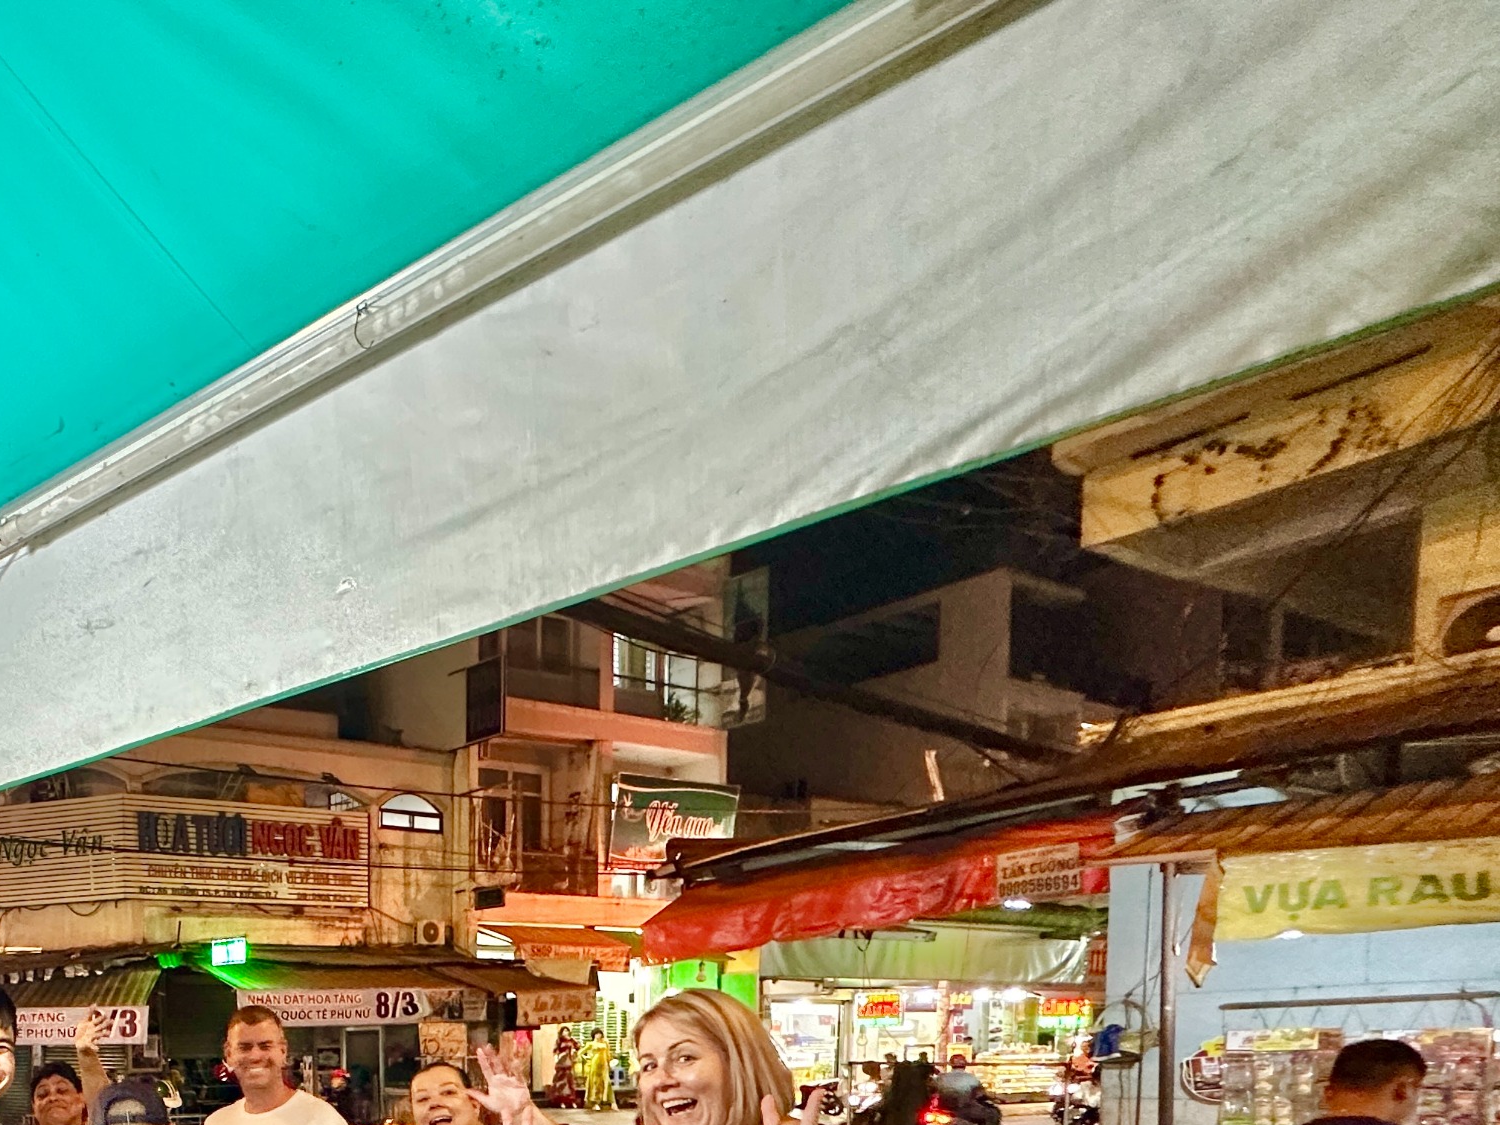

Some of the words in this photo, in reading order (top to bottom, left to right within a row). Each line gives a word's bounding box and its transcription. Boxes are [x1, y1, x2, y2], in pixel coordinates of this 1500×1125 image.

[61, 827, 103, 856] Vân
[137, 810, 189, 852] HOA
[319, 816, 361, 861] VÂN
[1242, 876, 1349, 921] VỰA
[1367, 870, 1492, 907] RAU
[307, 993, 331, 1005] HOA
[376, 991, 420, 1020] 8/3
